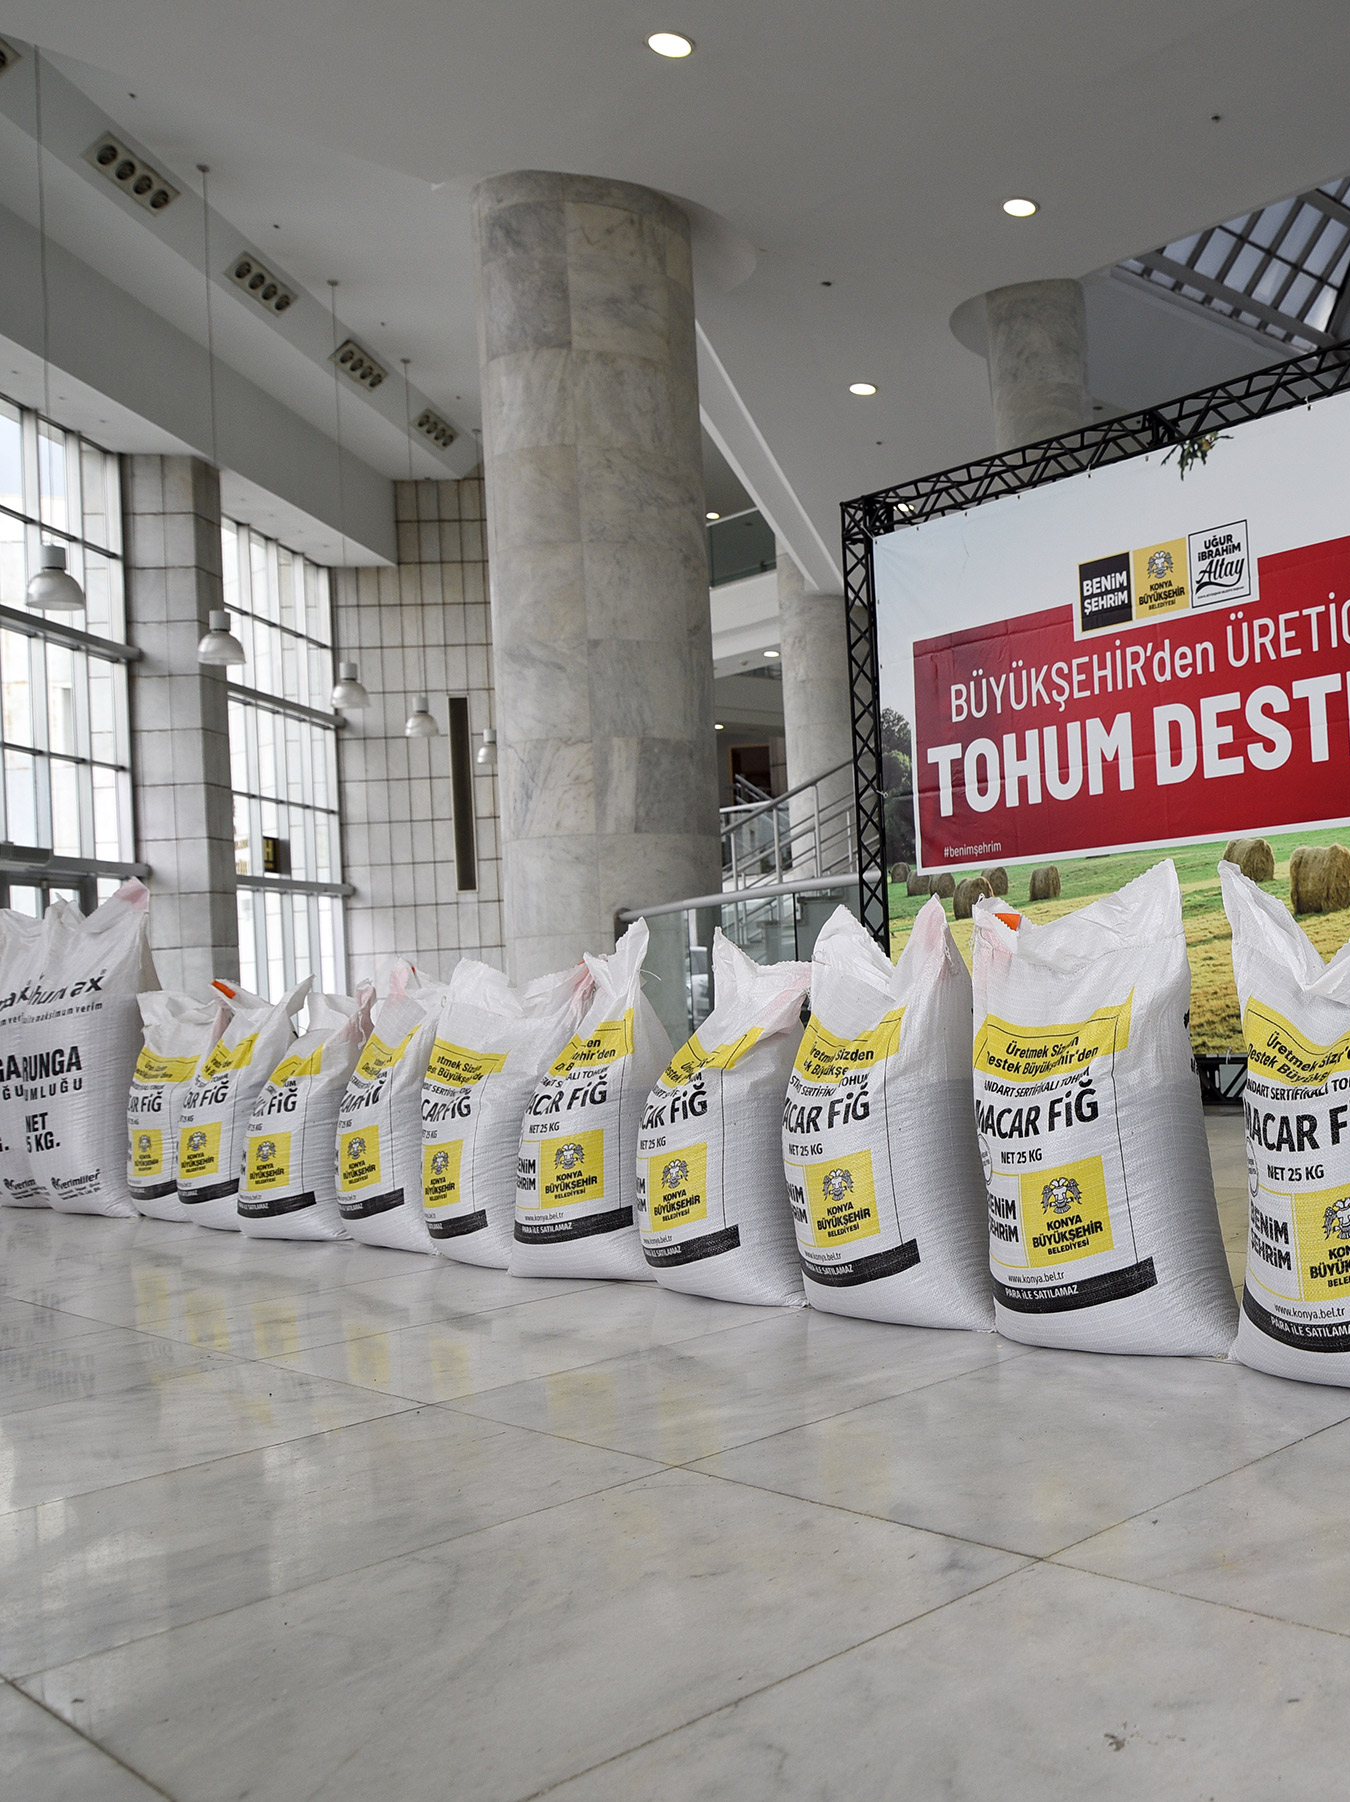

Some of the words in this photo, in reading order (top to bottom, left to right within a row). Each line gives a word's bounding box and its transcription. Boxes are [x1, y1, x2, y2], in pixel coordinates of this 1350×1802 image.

[1204, 534, 1233, 550] UĞUR
[1196, 557, 1246, 594] Altay
[1150, 579, 1173, 592] KONYA
[1139, 586, 1185, 606] BÜYÜKŞEHİR
[927, 712, 1136, 818] TOHUM
[944, 840, 1002, 858] #benimşehrim
[76, 1002, 103, 1014] verim
[1006, 1040, 1049, 1059] Üretmek
[987, 1051, 1021, 1074] estek
[800, 1145, 809, 1156] 25
[810, 1143, 823, 1155] KG
[1001, 1151, 1015, 1164] NET
[1017, 1151, 1027, 1164] 25
[1029, 1148, 1042, 1163] KG
[556, 1170, 583, 1182] KONYA
[1267, 1164, 1286, 1181] NET
[1288, 1167, 1302, 1181] 25
[1305, 1164, 1325, 1181] KG
[545, 1175, 598, 1194] BÜYÜKŞEHİR
[663, 1189, 687, 1202] KONYA
[653, 1194, 701, 1216] BÜYÜKŞEHİR
[826, 1201, 854, 1216] KONYA
[816, 1207, 871, 1231] BÜYÜKŞEHİR
[1046, 1214, 1082, 1231] KONYA
[827, 1222, 860, 1237] BELEDİYESİ
[1032, 1220, 1103, 1248] BÜYÜKŞEHİR
[1047, 1238, 1089, 1255] BELEDİYESİ
[1034, 1285, 1079, 1299] SATILAMAZ
[1274, 1304, 1346, 1321] www.konya.bel.tr
[1271, 1316, 1290, 1332] PARA
